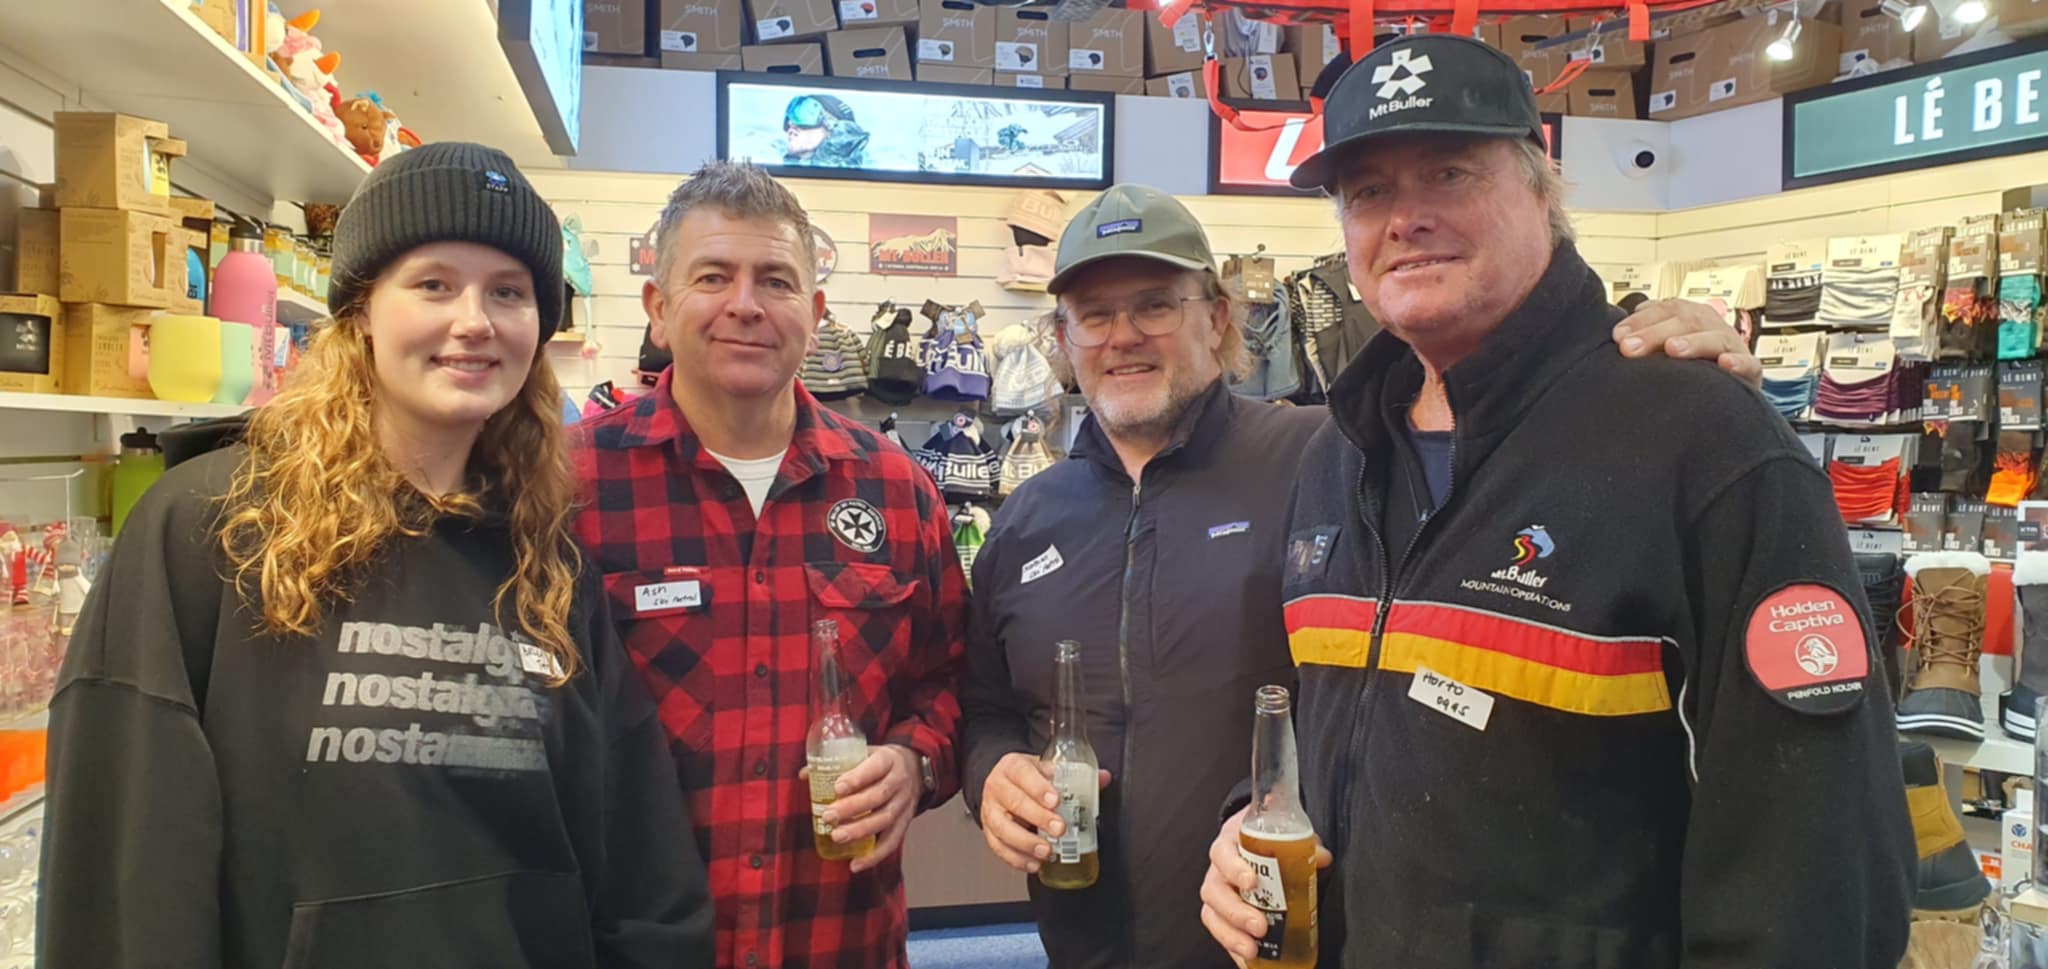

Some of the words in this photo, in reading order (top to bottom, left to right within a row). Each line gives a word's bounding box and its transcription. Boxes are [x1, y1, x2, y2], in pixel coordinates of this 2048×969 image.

[686, 5, 718, 17] SMITH
[943, 18, 974, 29] SMITH
[1017, 27, 1048, 38] SMITH
[1093, 28, 1123, 39] SMITH
[856, 64, 889, 76] SMITH
[1894, 76, 1946, 145] LÉ
[1770, 600, 1835, 618] Holden
[1769, 613, 1844, 632] Captiva
[338, 621, 524, 677] nostalg
